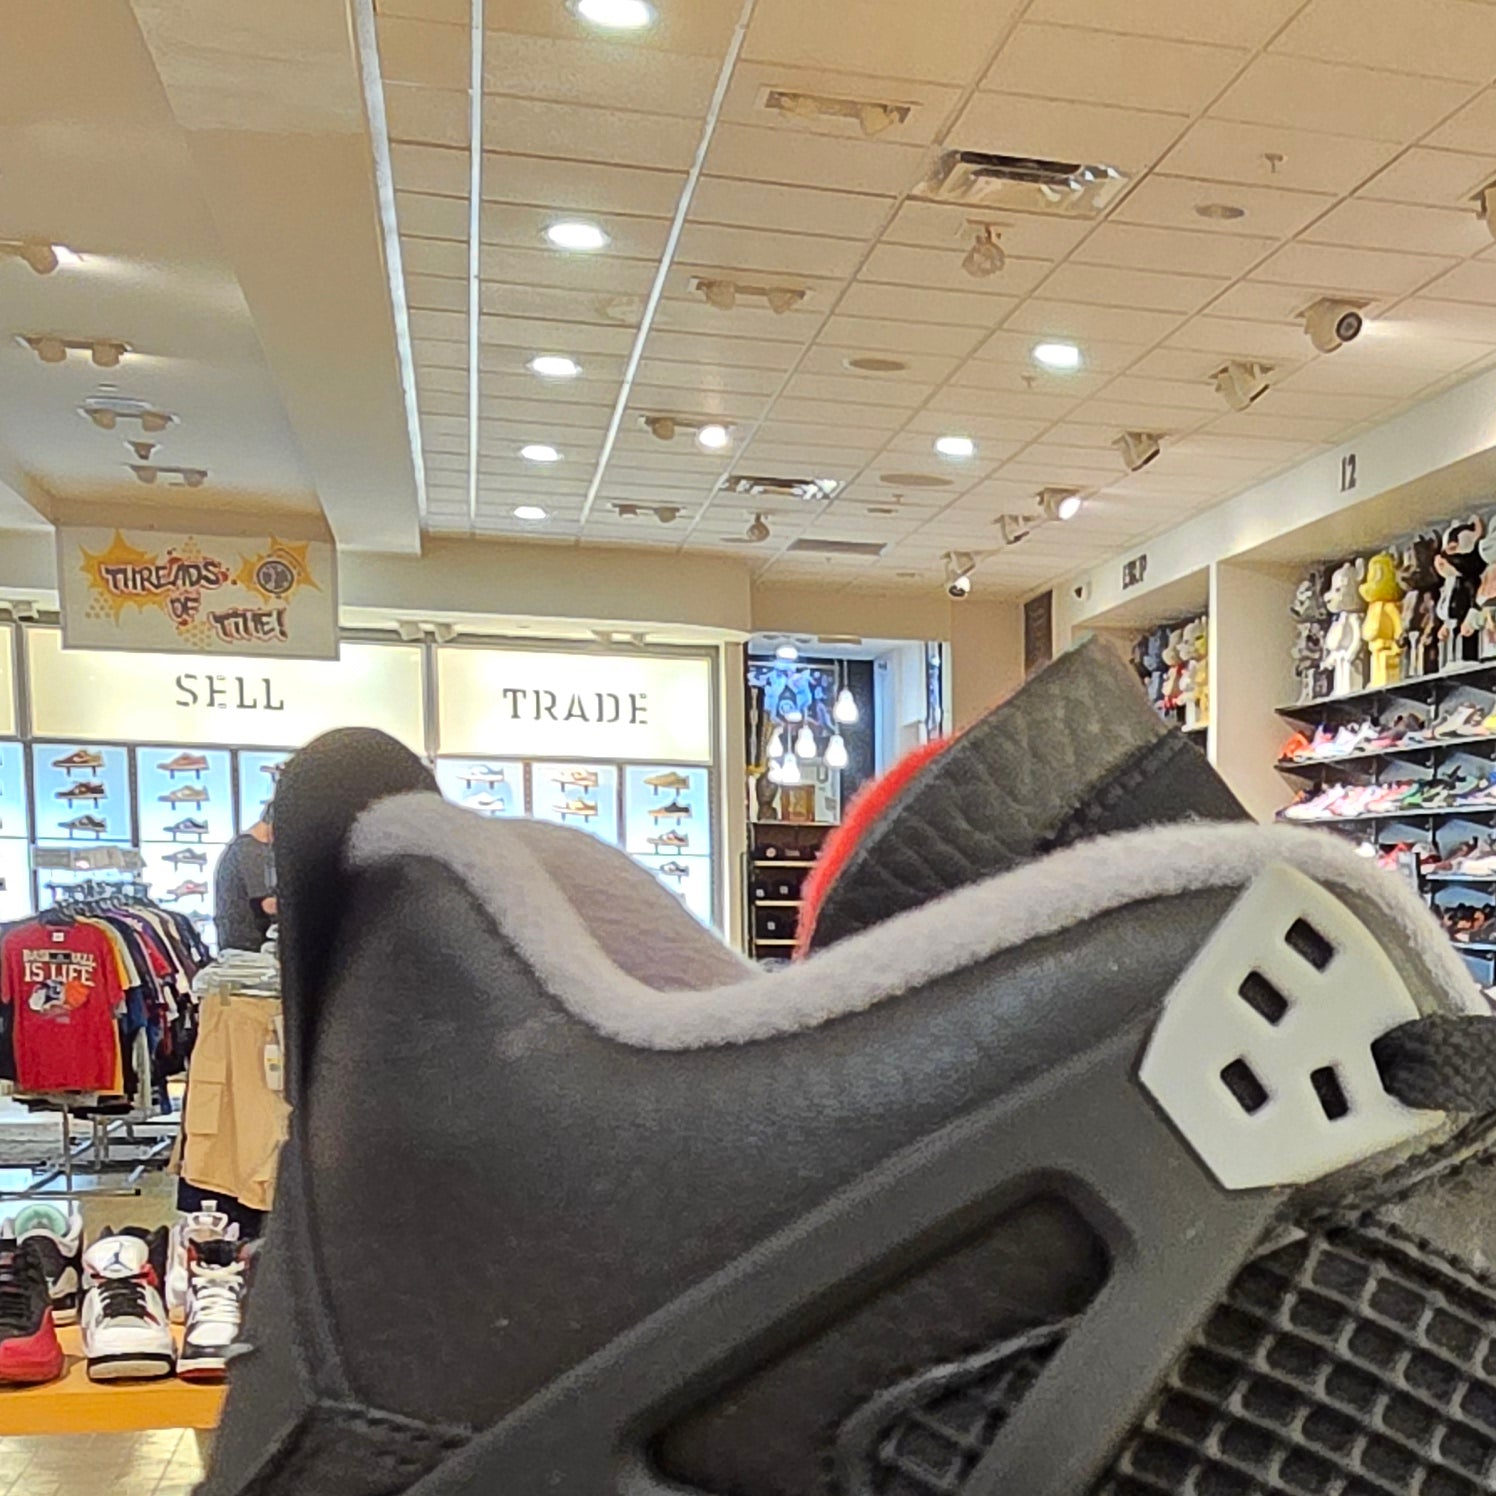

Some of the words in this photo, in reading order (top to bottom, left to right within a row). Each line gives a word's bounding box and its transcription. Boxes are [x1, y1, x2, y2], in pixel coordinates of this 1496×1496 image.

[103, 560, 221, 591] THREADS
[169, 597, 200, 619] OF
[175, 673, 284, 711] SELL
[502, 688, 648, 725] TRADE
[24, 962, 45, 982] IS
